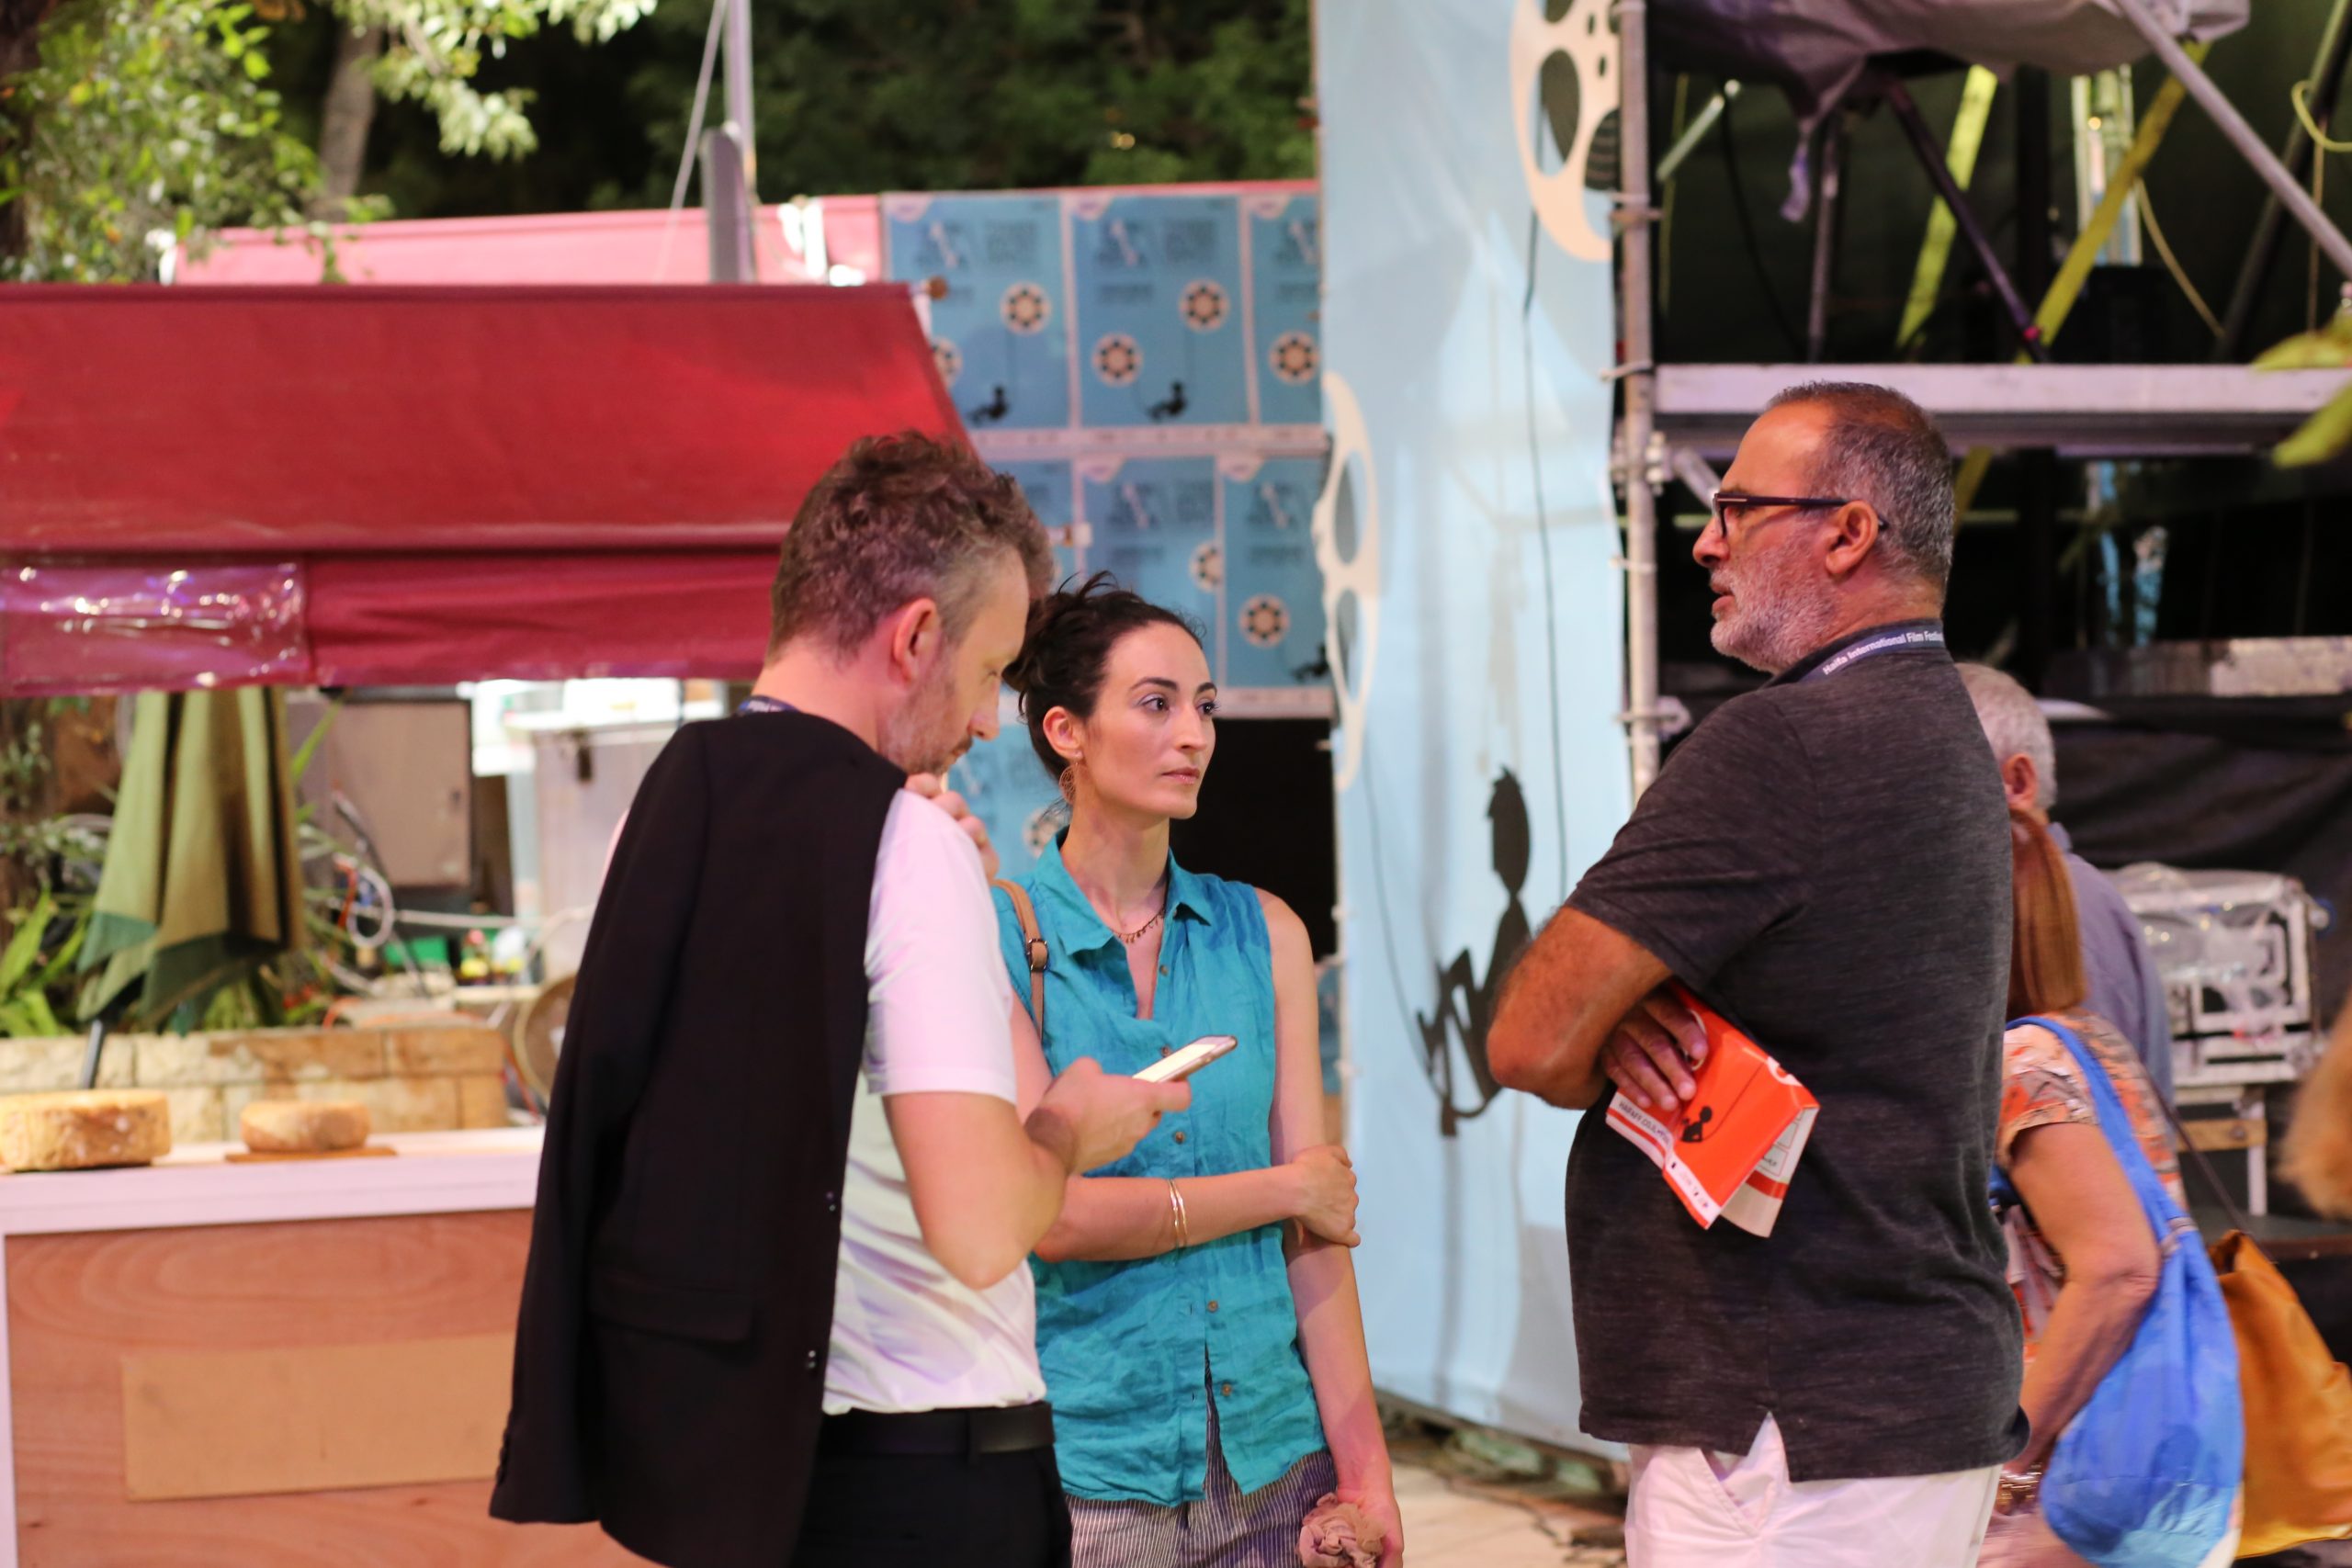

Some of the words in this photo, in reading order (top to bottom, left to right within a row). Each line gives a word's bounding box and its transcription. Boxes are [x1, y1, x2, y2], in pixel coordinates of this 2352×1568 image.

[1823, 654, 1848, 675] Haifa
[1848, 634, 1906, 660] International
[1906, 632, 1924, 643] Film
